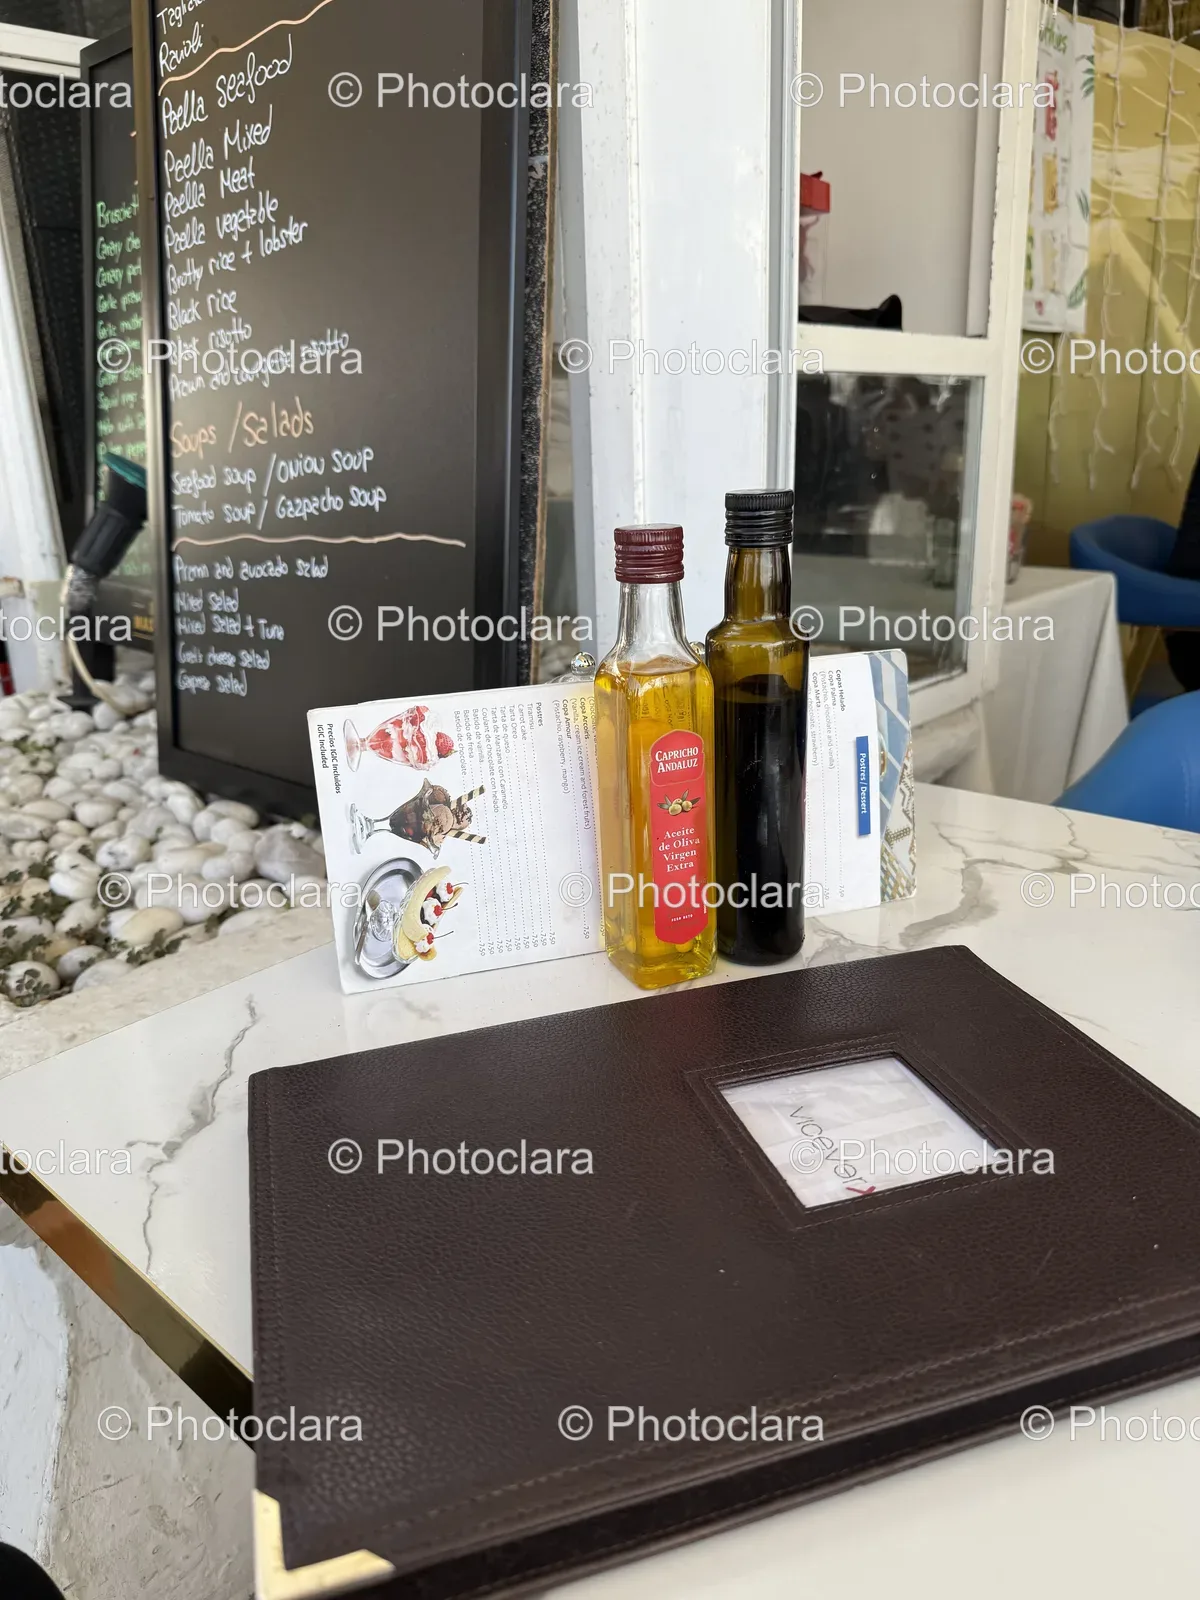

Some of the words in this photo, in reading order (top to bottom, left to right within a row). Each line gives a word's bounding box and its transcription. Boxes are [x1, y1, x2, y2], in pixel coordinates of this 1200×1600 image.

[162, 89, 209, 139] Paella
[164, 138, 214, 188] Paella
[223, 103, 274, 161] Mixed
[164, 181, 207, 223] Paella
[219, 155, 256, 199] Meat
[164, 216, 207, 260] Paella
[208, 250, 237, 276] rice
[206, 287, 239, 318] rice
[169, 420, 218, 461] Soups
[491, 707, 499, 724] Tarta
[508, 705, 516, 722] Tarta
[518, 704, 526, 724] Carrot
[536, 702, 544, 727] Postres
[562, 699, 570, 716] Copa
[579, 697, 587, 714] Copa
[454, 711, 462, 732] Batido
[463, 710, 471, 731] Batido
[472, 709, 481, 730] Batido
[481, 708, 490, 733] Coulant
[526, 703, 535, 730] Tiramisu
[327, 723, 336, 748] Precios
[457, 733, 464, 742] de
[466, 732, 473, 741] de
[475, 731, 482, 740] de
[493, 725, 500, 734] de
[502, 724, 509, 732] de
[564, 717, 572, 739] Amour
[574, 725, 583, 745] cream
[582, 715, 590, 740] Arcoiris
[485, 734, 492, 743] de
[502, 733, 510, 754] queso
[319, 740, 329, 768] Included
[330, 749, 338, 762] IGIC
[458, 743, 467, 776] chocolate
[467, 742, 475, 758] fresa
[486, 744, 495, 776] chocolate
[494, 735, 503, 765] Manzana
[577, 756, 585, 776] cream
[332, 764, 341, 794] Incluidos
[492, 791, 500, 813] helado
[499, 779, 508, 810] Caramelo
[860, 786, 868, 814] Dessert
[664, 827, 695, 840] Aceite
[659, 842, 671, 852] de
[673, 837, 701, 849] Oliva
[663, 849, 697, 863] Virgen
[667, 860, 694, 873] Extra
